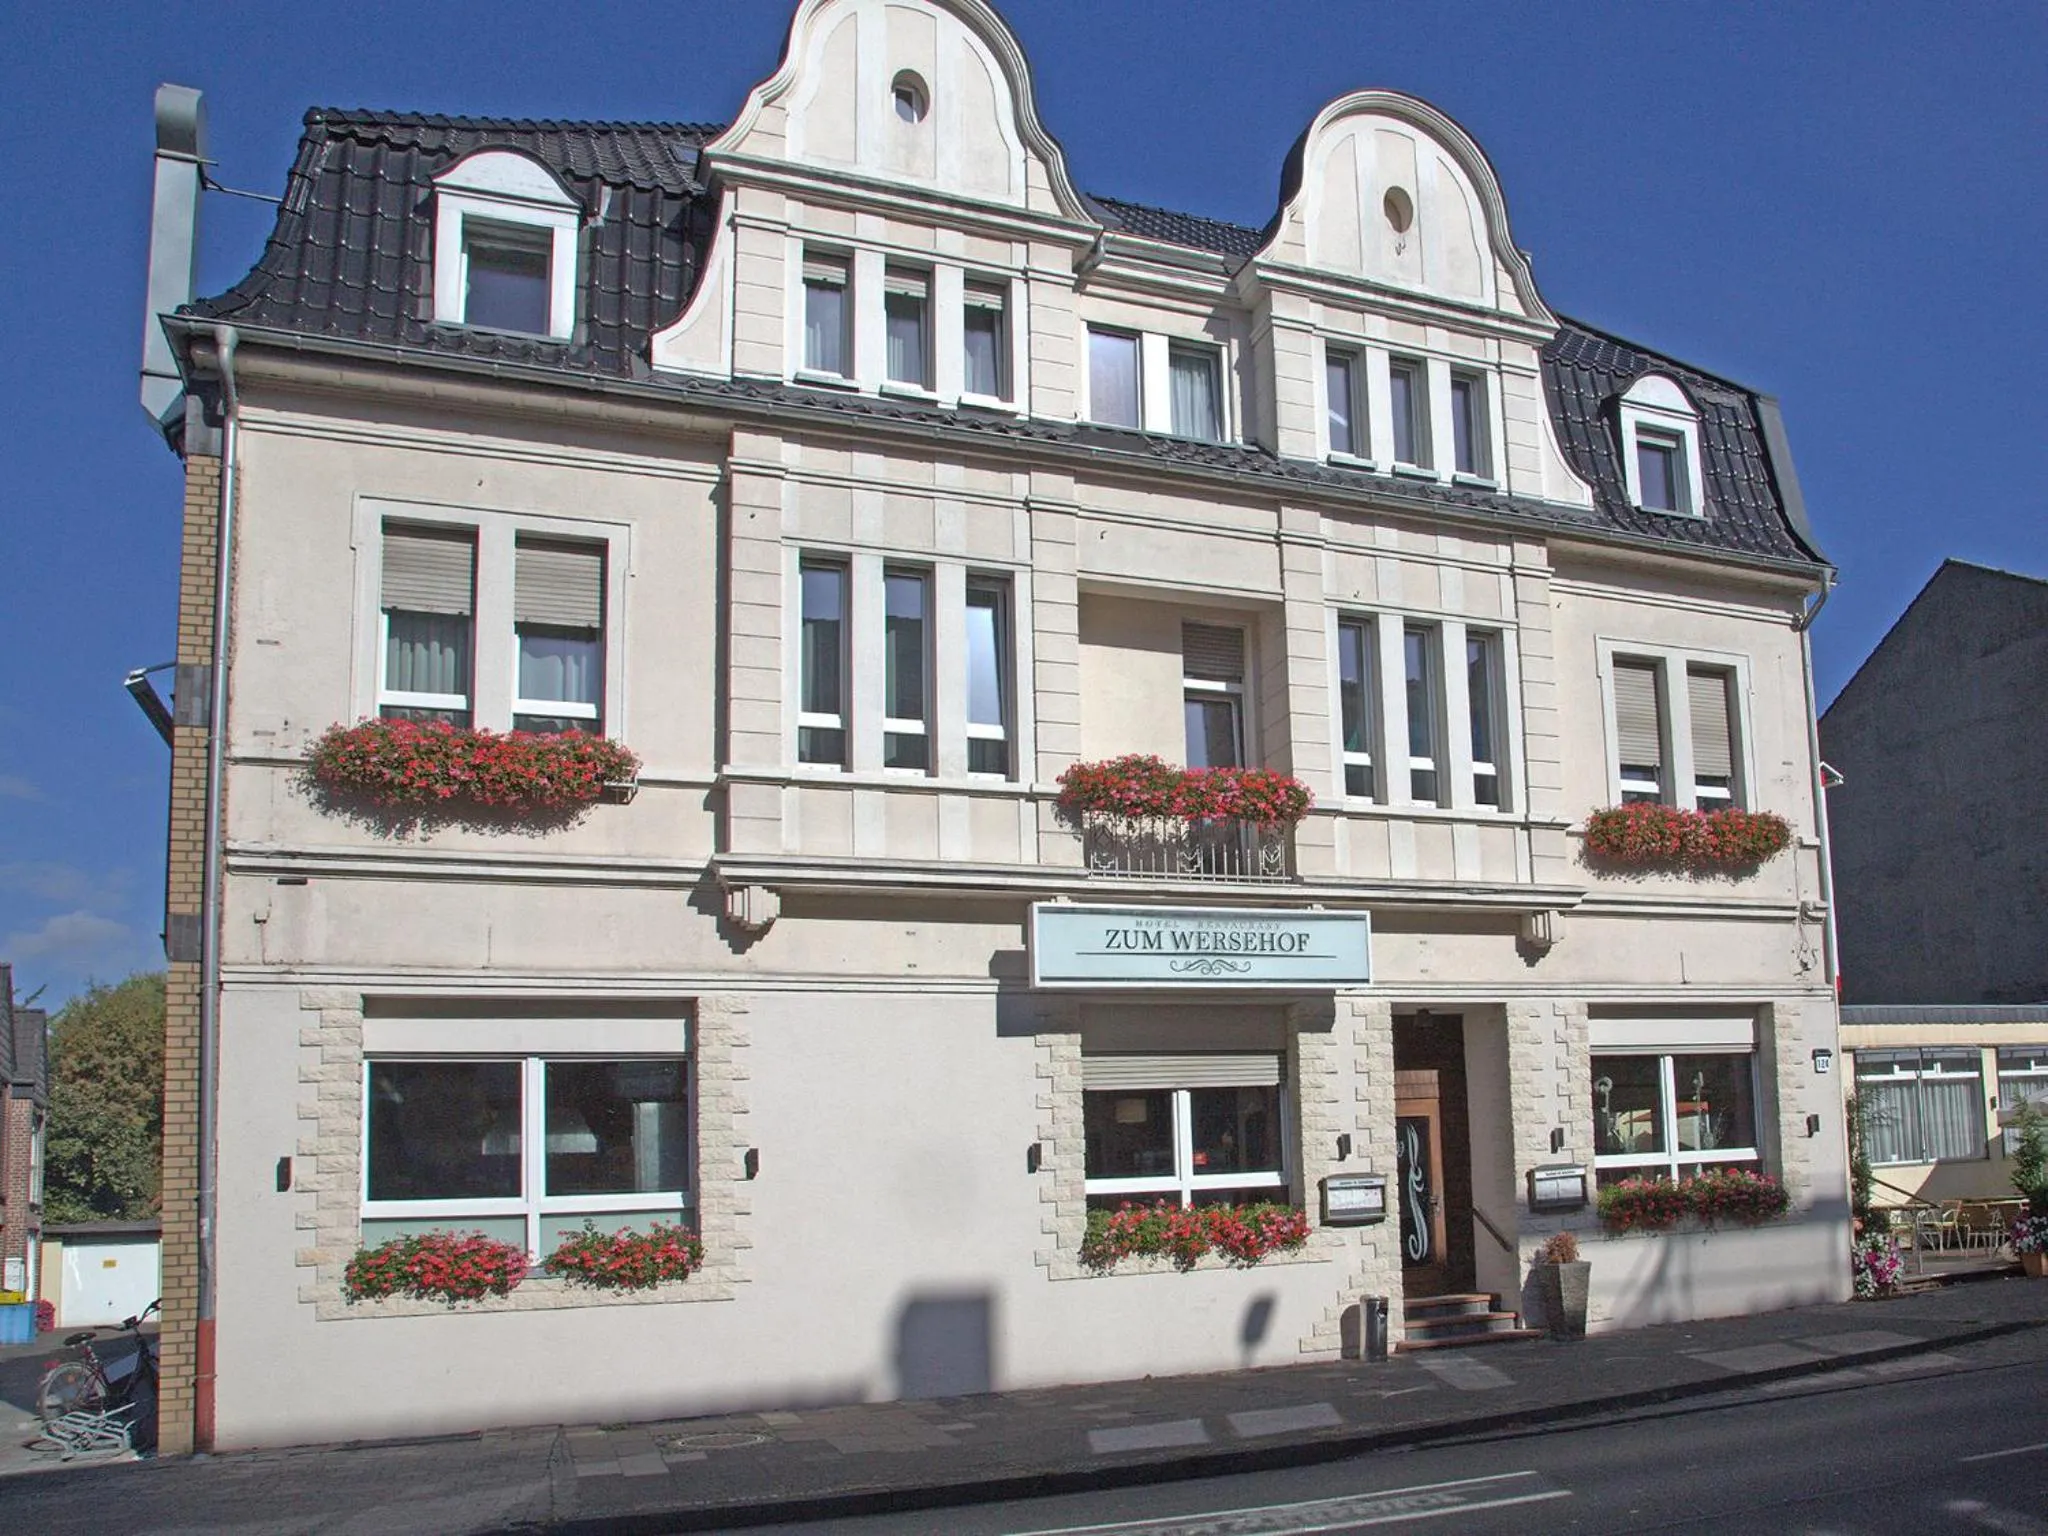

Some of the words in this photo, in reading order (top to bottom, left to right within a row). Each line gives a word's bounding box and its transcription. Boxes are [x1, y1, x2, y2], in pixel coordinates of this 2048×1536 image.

[1135, 919, 1180, 929] HOTEL
[1106, 929, 1162, 950] ZUM
[1171, 931, 1310, 953] WERSEHOF
